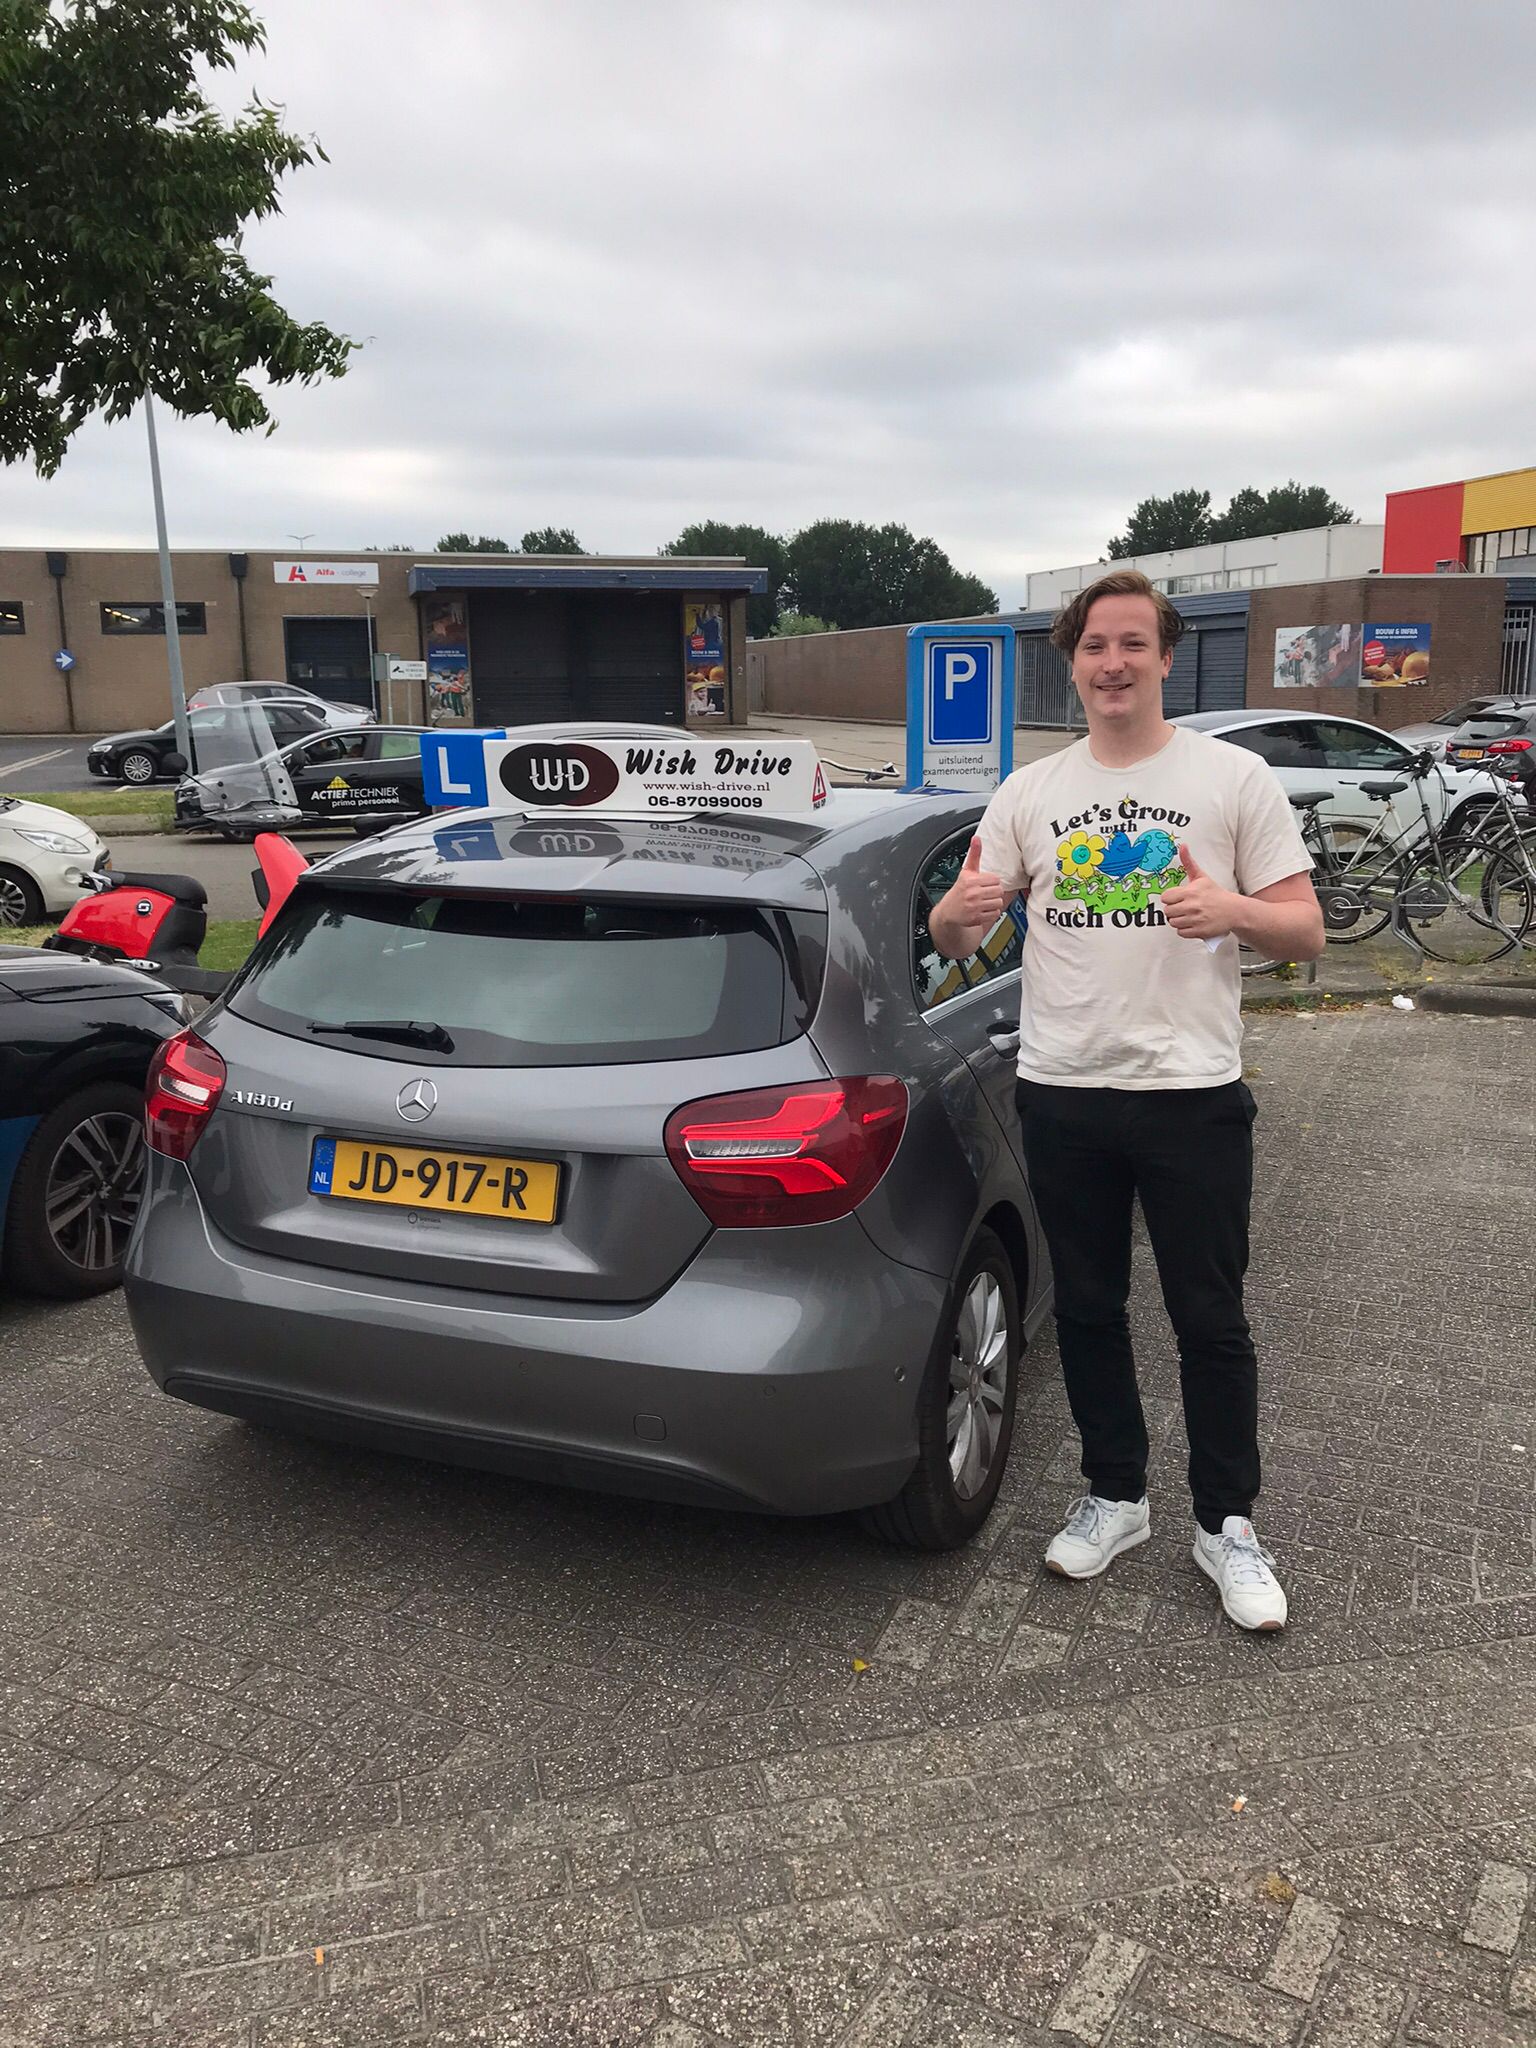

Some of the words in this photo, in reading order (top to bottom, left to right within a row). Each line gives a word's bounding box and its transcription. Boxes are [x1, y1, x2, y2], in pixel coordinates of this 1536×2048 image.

[945, 653, 977, 700] P
[625, 748, 697, 775] Wish
[714, 748, 792, 776] Drive
[938, 755, 983, 765] uitsluitend
[437, 746, 471, 794] L
[923, 766, 999, 777] examenvoertuigen
[311, 789, 349, 801] ACTIEF
[349, 787, 399, 798] TECHNIEK
[643, 782, 770, 792] www.wish-drive.nl
[331, 800, 356, 808] prima
[358, 797, 400, 807] personeel
[648, 796, 763, 808] 06-87099009
[1050, 803, 1112, 839] Let's
[1118, 799, 1191, 828] Grow
[1100, 820, 1138, 834] with
[1046, 905, 1104, 928] Each
[1110, 902, 1166, 928] Oth
[314, 1171, 330, 1186] NL
[348, 1151, 528, 1211] JD-917-R
